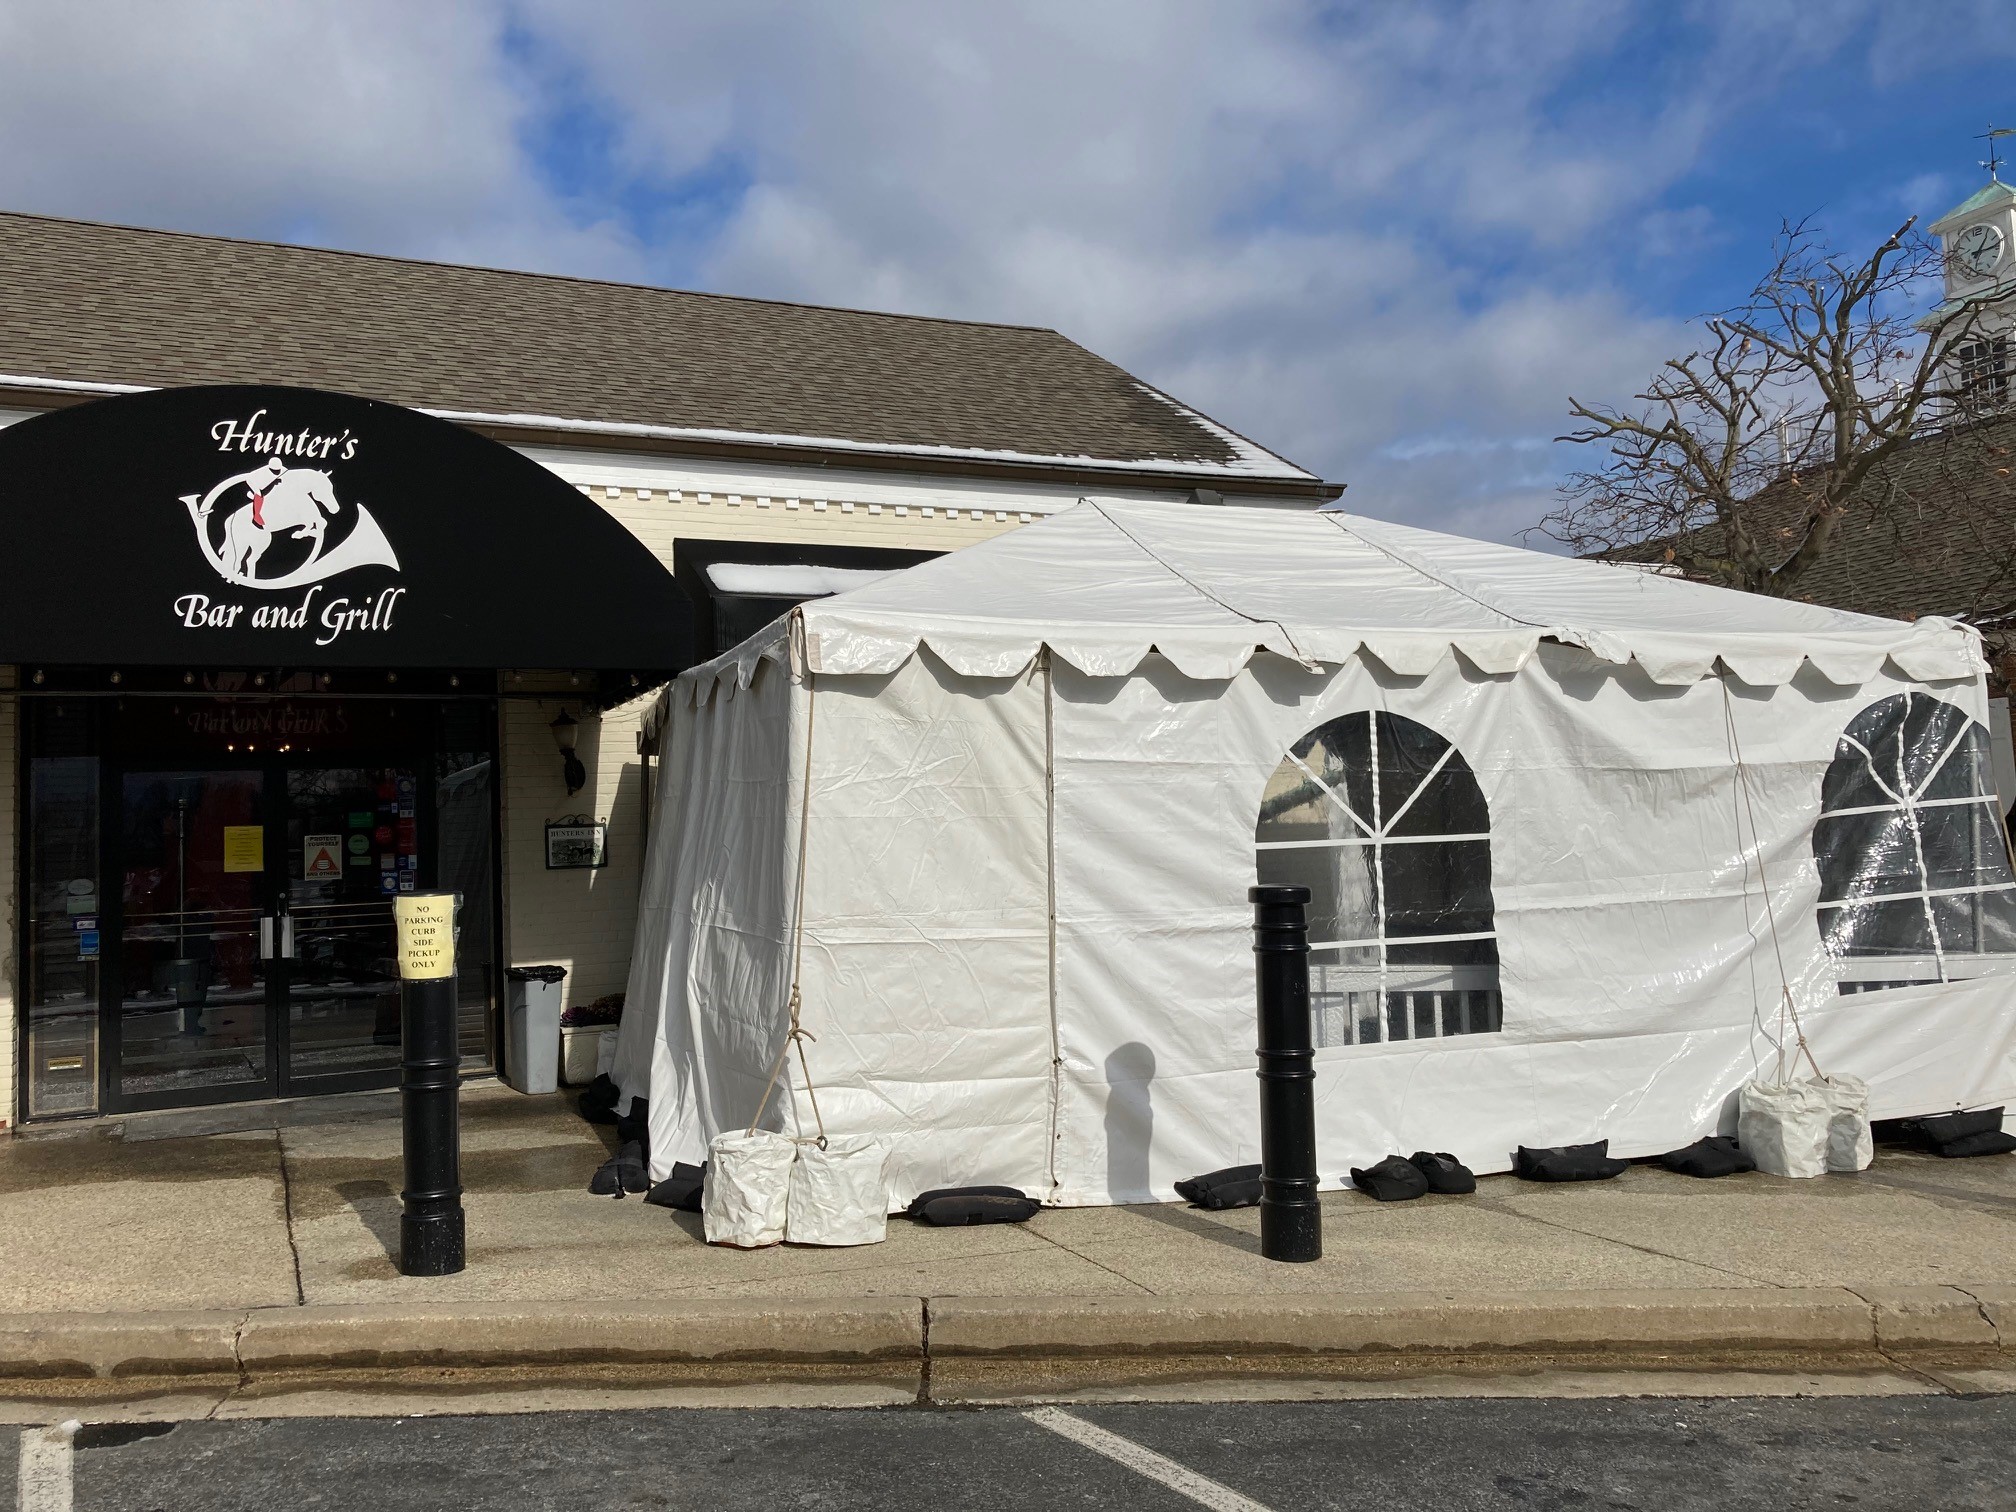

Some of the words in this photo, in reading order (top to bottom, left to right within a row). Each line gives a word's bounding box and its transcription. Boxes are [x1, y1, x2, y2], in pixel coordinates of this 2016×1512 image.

[1972, 227, 1983, 237] 12
[210, 409, 359, 460] Hunter's
[174, 594, 244, 628] Bar
[252, 585, 323, 629] and
[315, 588, 406, 646] Grill
[404, 916, 444, 925] PARKING
[411, 927, 436, 936] CURB
[413, 938, 434, 947] SIDE
[408, 949, 441, 958] PICKUP
[411, 960, 437, 969] ONLY
